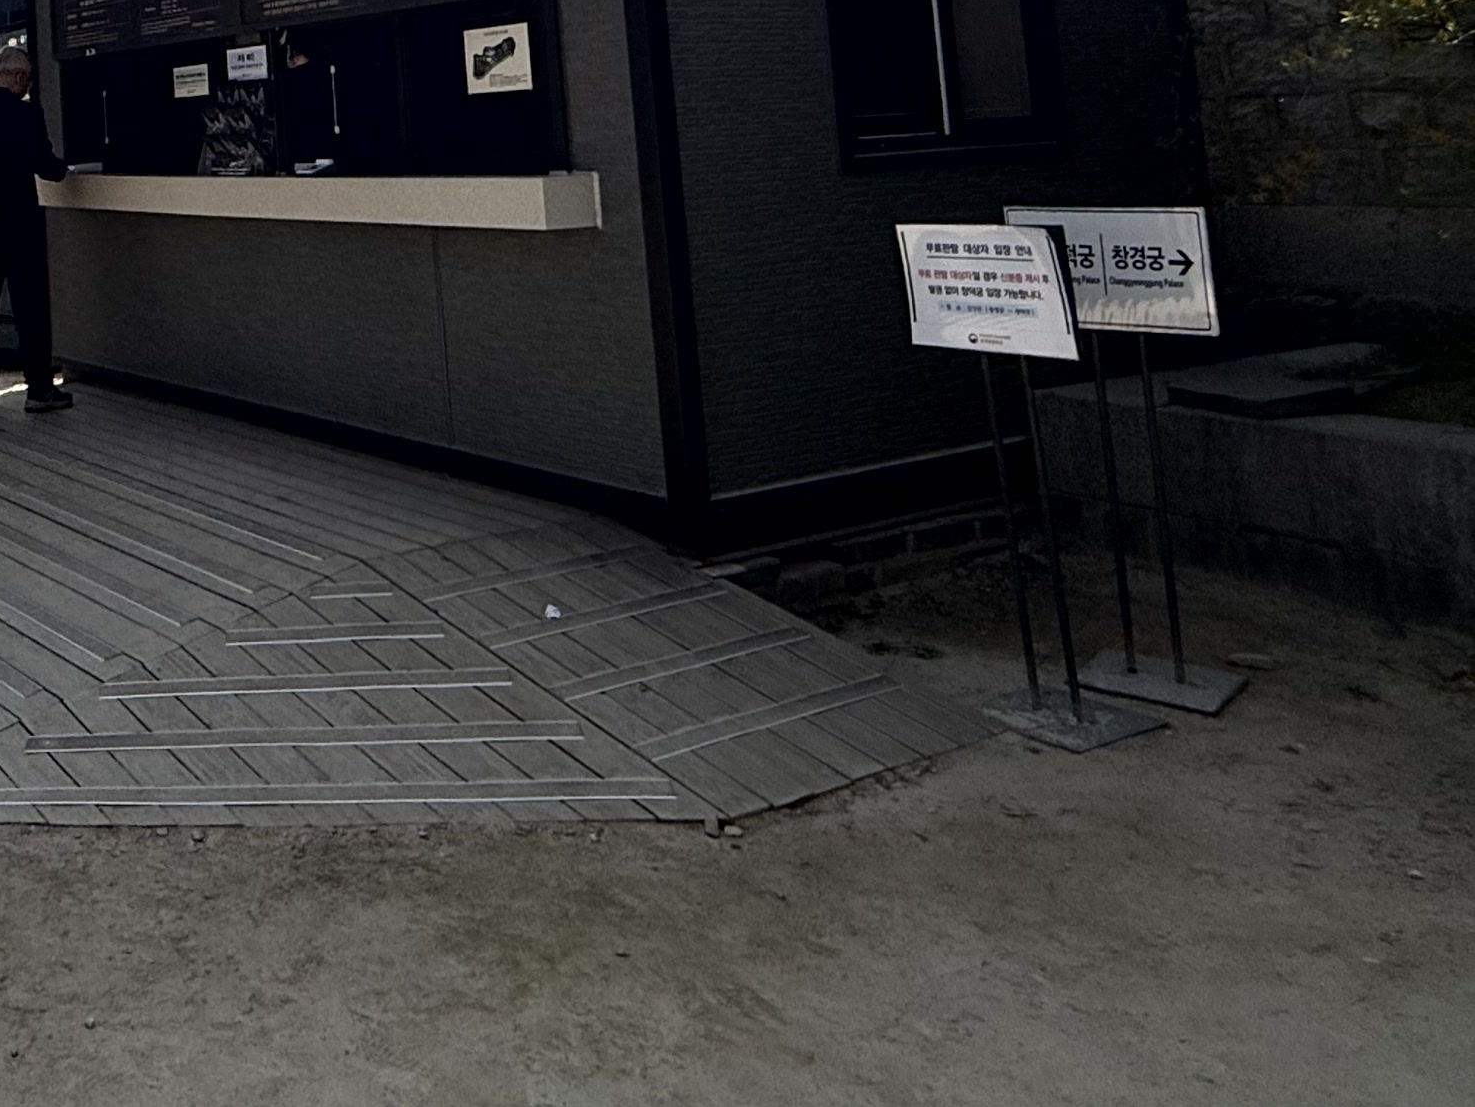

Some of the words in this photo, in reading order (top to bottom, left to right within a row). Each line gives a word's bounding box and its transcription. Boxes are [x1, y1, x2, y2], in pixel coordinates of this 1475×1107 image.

[963, 244, 989, 254] 대상자
[993, 244, 1011, 255] 입장
[1015, 245, 1033, 256] 안내
[1066, 244, 1095, 269] 덕궁
[1112, 245, 1165, 271] 창경궁
